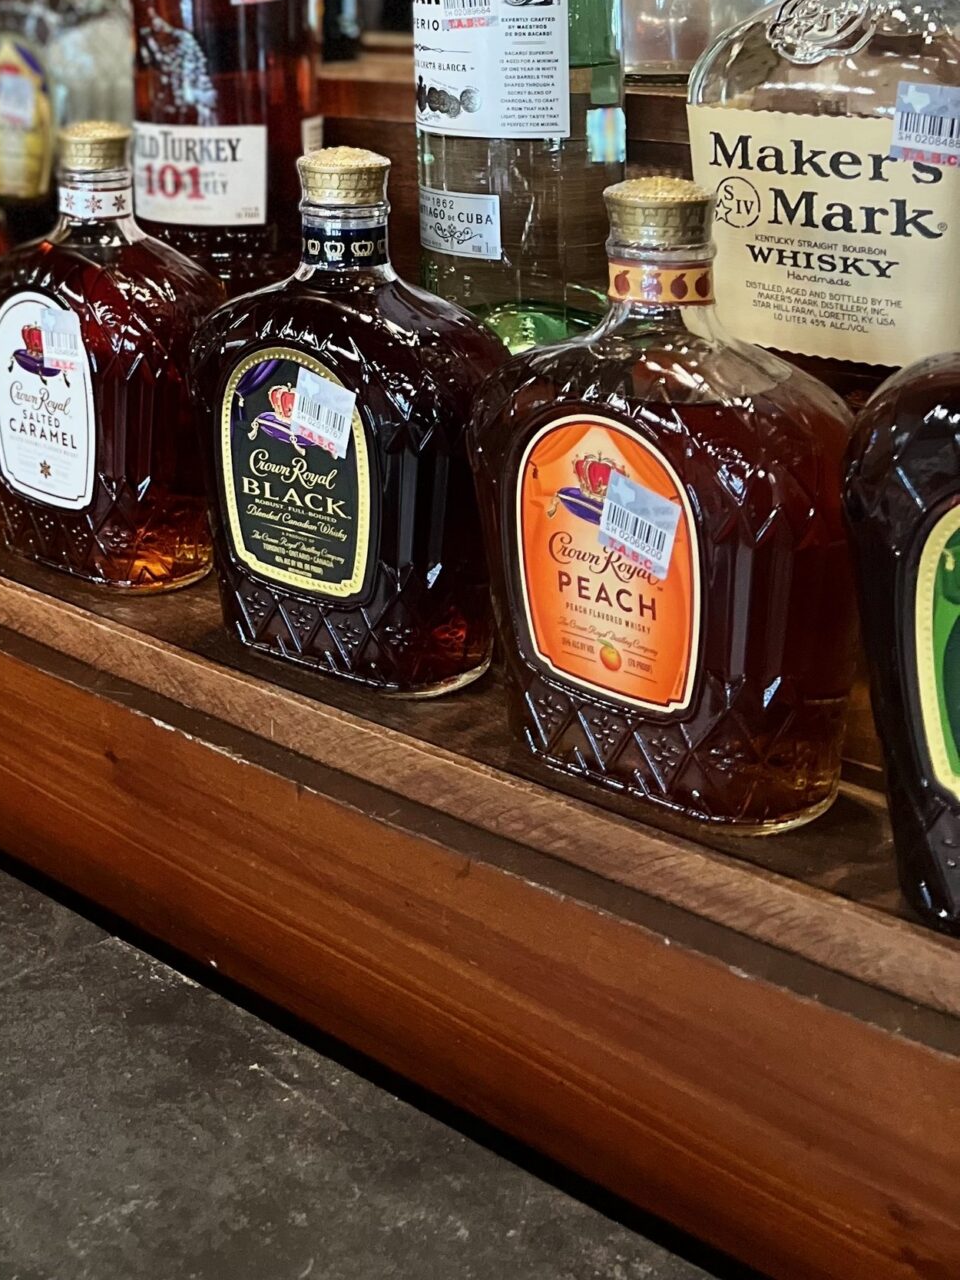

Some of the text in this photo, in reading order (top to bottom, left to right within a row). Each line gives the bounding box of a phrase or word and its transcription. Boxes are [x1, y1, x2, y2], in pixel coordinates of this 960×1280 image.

[160, 130, 242, 163] TURKEY
[709, 131, 942, 184] Makers
[145, 163, 205, 201] 101
[724, 185, 734, 200] S
[432, 196, 454, 209] 1862
[457, 212, 493, 225] CUBA
[736, 199, 754, 215] IV
[768, 187, 943, 239] Mark
[755, 233, 887, 256] KENTUCKY STRAIGHT BOURBON
[746, 244, 899, 279] WHISKY
[745, 280, 903, 309] DISTILLED, AGED AND BOTTLED BY THE
[787, 270, 852, 287] Handmade
[752, 299, 771, 310] STAR
[773, 303, 790, 313] HILL
[791, 306, 817, 317] FARM,
[819, 311, 859, 323] LORETTO,
[877, 317, 896, 327] USA
[757, 291, 888, 317] MAKER'S MARK DISTILLERY, INC.
[785, 315, 807, 325] LITER
[810, 318, 826, 328] 45%
[10, 381, 71, 416] Crown Royal
[10, 418, 77, 450] CARAMEL
[23, 409, 60, 428] SALTED
[249, 449, 337, 490] Crown Royal
[242, 476, 348, 519] BLACK
[246, 503, 348, 542] Blended Canadian Whisky
[549, 531, 600, 565] Crown
[558, 571, 656, 620] PEACH
[566, 602, 651, 634] PEACH FLAVORED WHISKY
